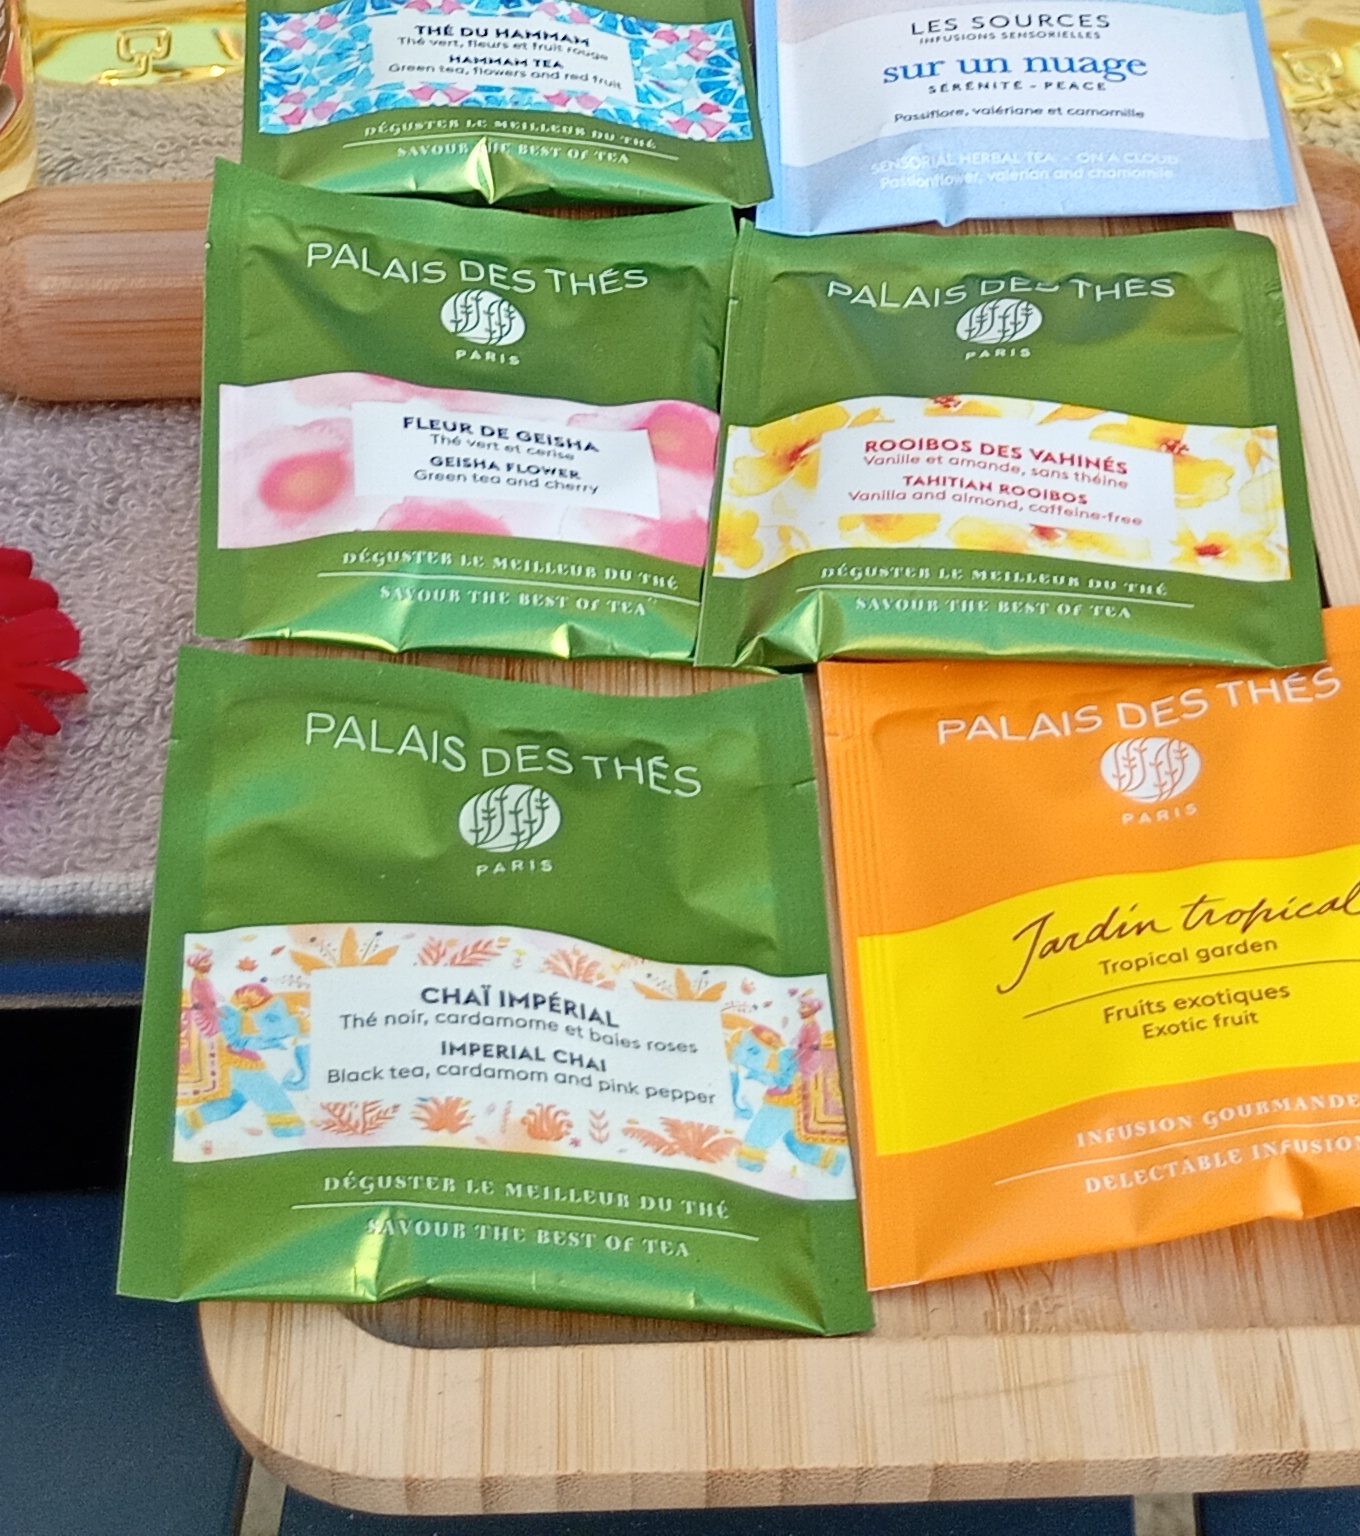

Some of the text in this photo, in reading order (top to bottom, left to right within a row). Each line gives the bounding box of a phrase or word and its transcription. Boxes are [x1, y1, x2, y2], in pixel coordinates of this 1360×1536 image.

[415, 25, 589, 47] THÉ DU HAMMAM
[911, 13, 1110, 35] LES SOURCES
[919, 30, 1101, 44] INFUSIONS SENSORIELLES
[398, 36, 609, 61] Thé vert, fleurs et fruit rouge
[449, 55, 564, 69] HAMMAM TEA
[389, 64, 622, 90] Green tea, flowers and red fruit
[882, 54, 1148, 83] sur un nuage
[928, 80, 1023, 94] SÉRÉNITÉ
[1044, 81, 1106, 92] PEACE
[894, 106, 1144, 123] Passiflore, valériane et camomille
[307, 243, 648, 296] PALAIS DES THÉS
[827, 280, 968, 308] PALAIS
[456, 349, 520, 365] PARIS
[964, 347, 1032, 360] PARIS
[403, 417, 600, 452] FLEUR DE GEISHA
[430, 434, 574, 461] Thé vert et cerise
[430, 456, 582, 480] GEISHA FLOWER
[865, 438, 1129, 475] ROOIBOS DES VAHINÉS
[414, 470, 599, 495] Green tea and cherry
[864, 454, 1129, 490] Vanille et amande, sans théine
[902, 475, 1088, 504] TAHITIAN ROOIBOS
[849, 490, 1142, 526] Vanilla and almond, caffeine-free
[937, 666, 1341, 745] PALAIS DES THÉS
[306, 712, 702, 798] PALAIS DES THÉS
[1122, 803, 1198, 824] PARIS
[476, 860, 553, 876] PARIS
[996, 903, 1172, 994] Jardin
[1099, 937, 1278, 975] Tropical garden
[420, 985, 620, 1029] CHAÏ IMPÉRIAL
[1103, 985, 1290, 1024] Fruits exotiques
[341, 1010, 698, 1054] Thé noir, cardamome et baies roses
[1143, 1010, 1259, 1040] Exotic fruit
[441, 1041, 607, 1072] IMPERIAL CHAI
[328, 1064, 716, 1105] Black tea, cardamom and pink pepper
[1077, 1093, 1360, 1148] INFUSION GOURMANDE
[1085, 1148, 1243, 1194] DELECTABLE
[323, 1170, 730, 1220] DÉGUSTER LE MEILLEUR DU THÉ
[366, 1218, 466, 1238] SAVOUR
[475, 1224, 526, 1242] THE
[537, 1230, 597, 1248] BEST
[642, 1238, 690, 1258] TEA
